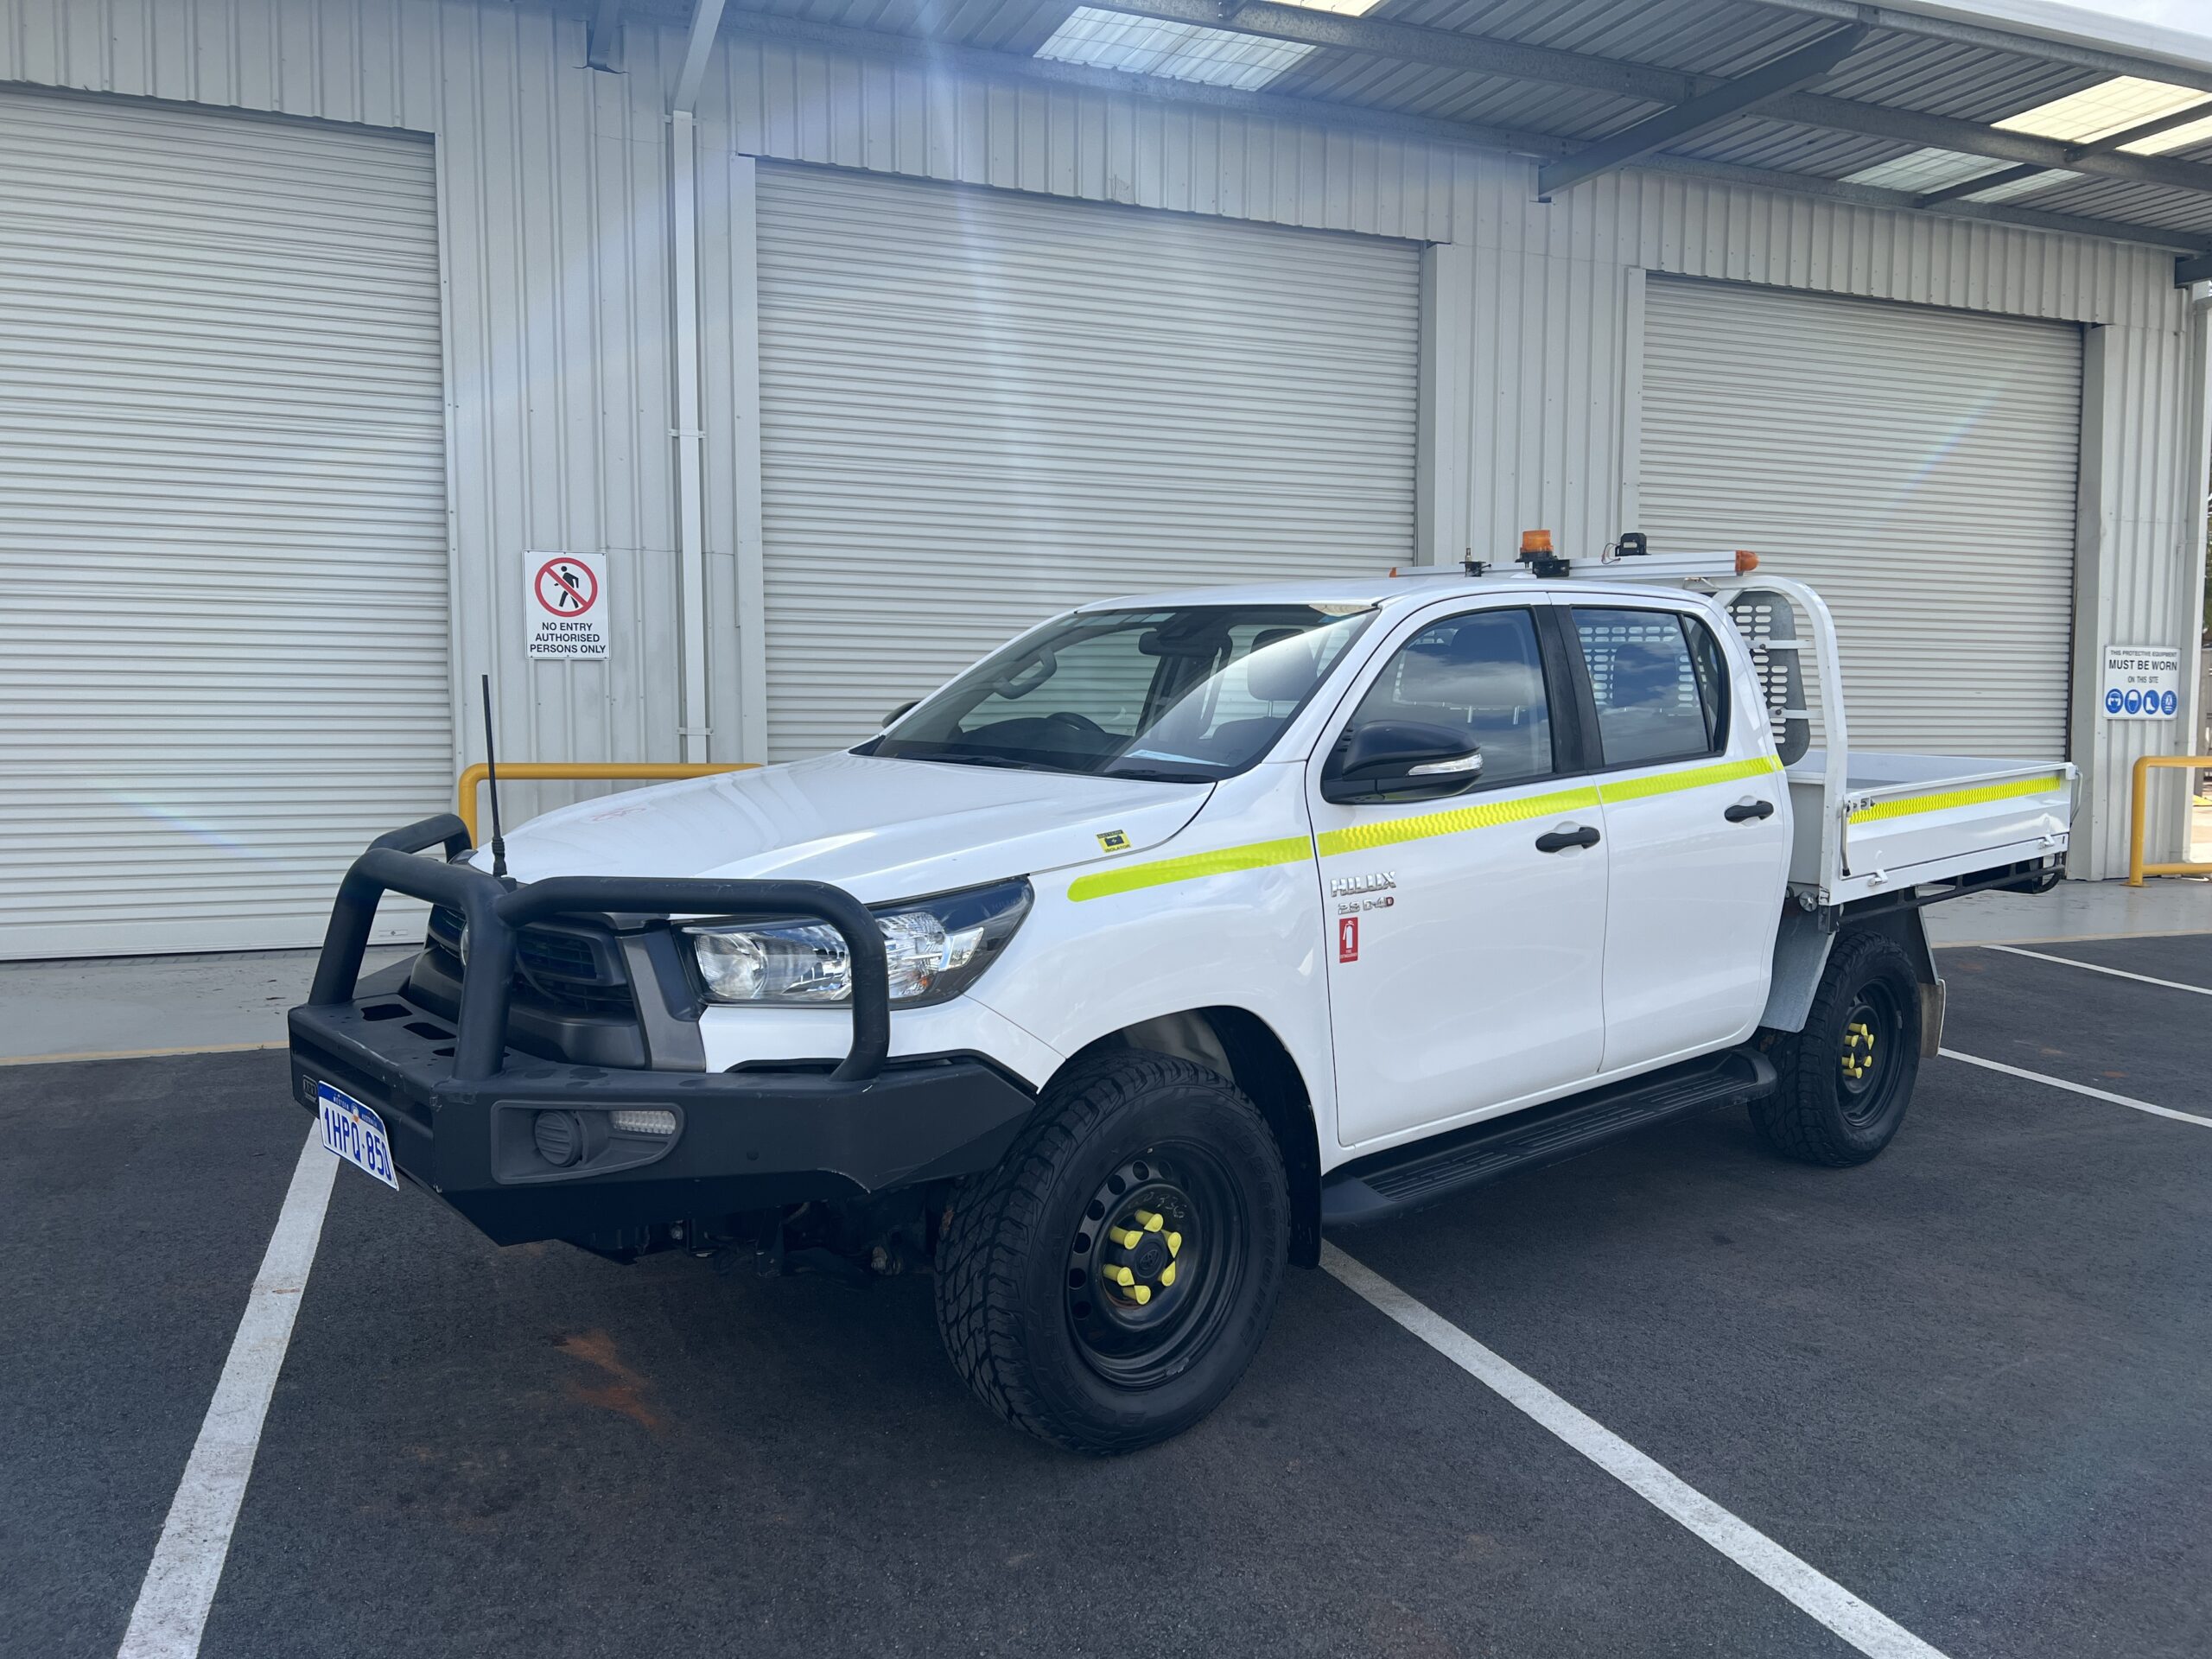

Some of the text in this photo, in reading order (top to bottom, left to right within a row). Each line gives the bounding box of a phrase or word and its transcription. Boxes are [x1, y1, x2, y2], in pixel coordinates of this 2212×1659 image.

[543, 622, 556, 631] NO
[535, 632, 601, 642] AUTHORISED
[530, 644, 606, 653] PERSONS ONLY
[2108, 659, 2177, 671] MUST BE WORN
[1331, 871, 1396, 897] HILUX
